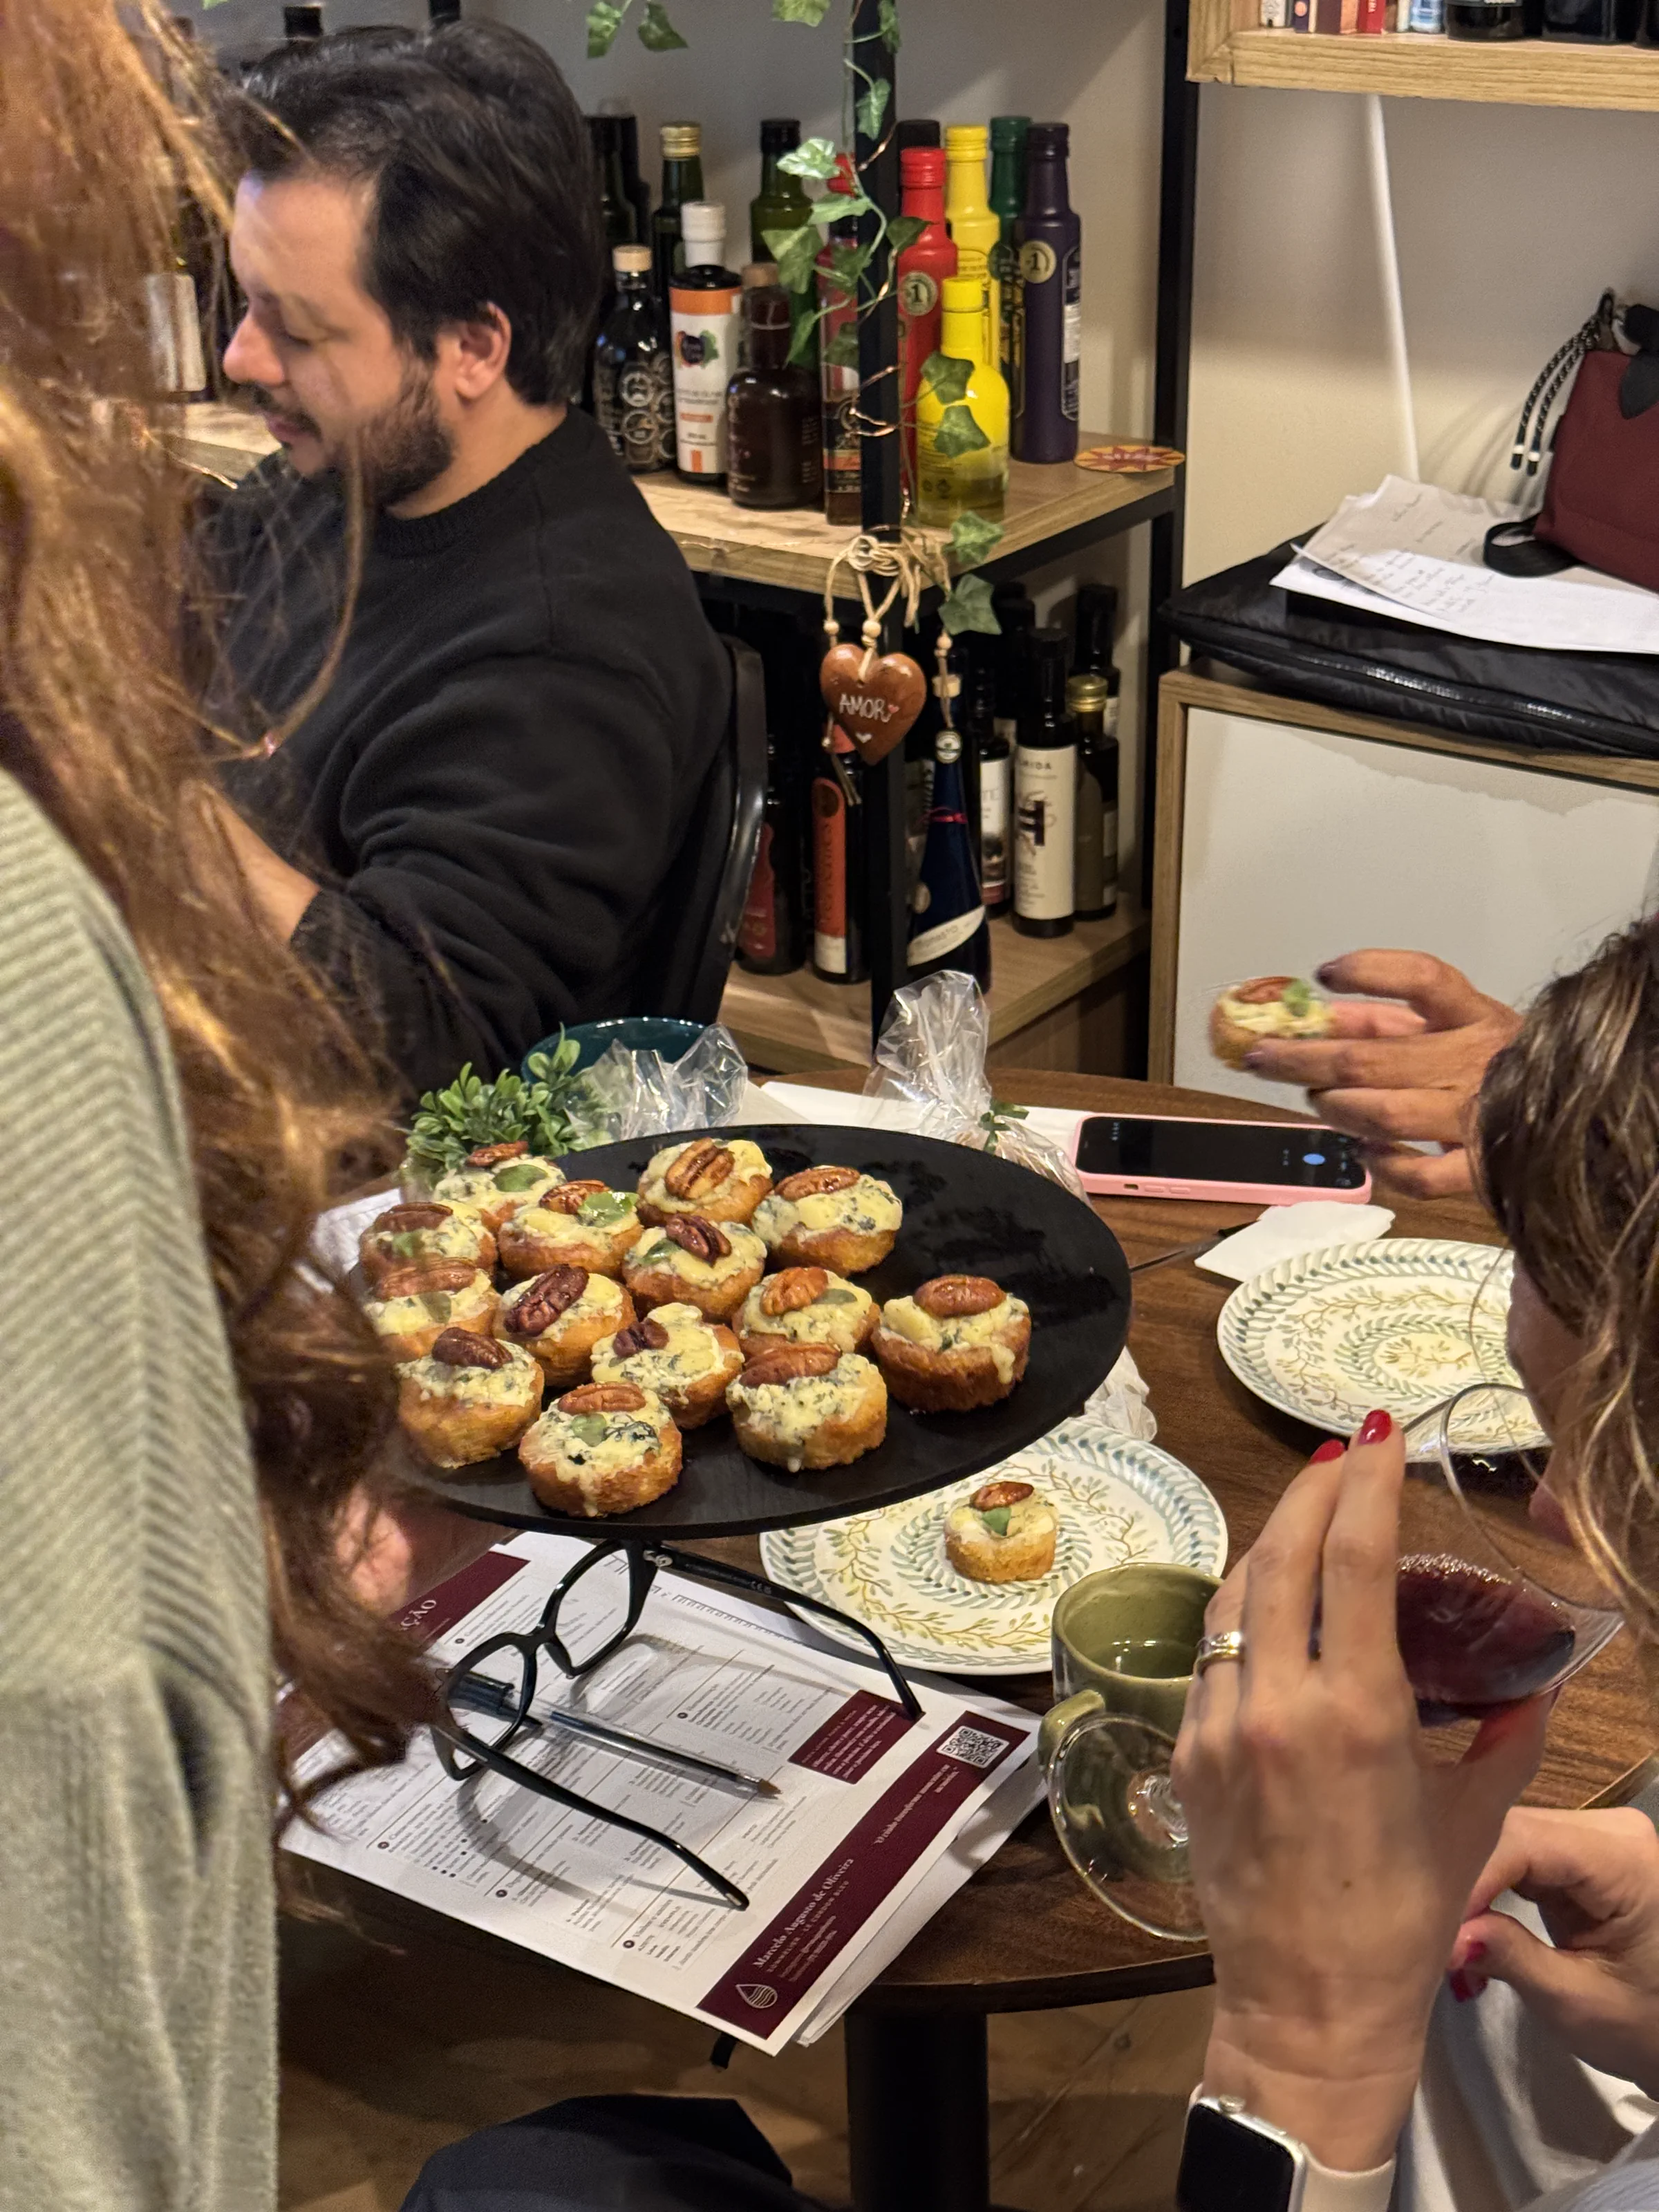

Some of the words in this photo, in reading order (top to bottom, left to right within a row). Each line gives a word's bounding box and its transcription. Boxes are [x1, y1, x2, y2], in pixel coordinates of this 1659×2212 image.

[839, 693, 892, 723] AMOR
[400, 1599, 437, 1631] ÇÃO
[751, 1934, 787, 1967] Marcelo
[783, 1901, 816, 1935] Augusto
[812, 1890, 826, 1901] de
[821, 1858, 854, 1889] Oliveira
